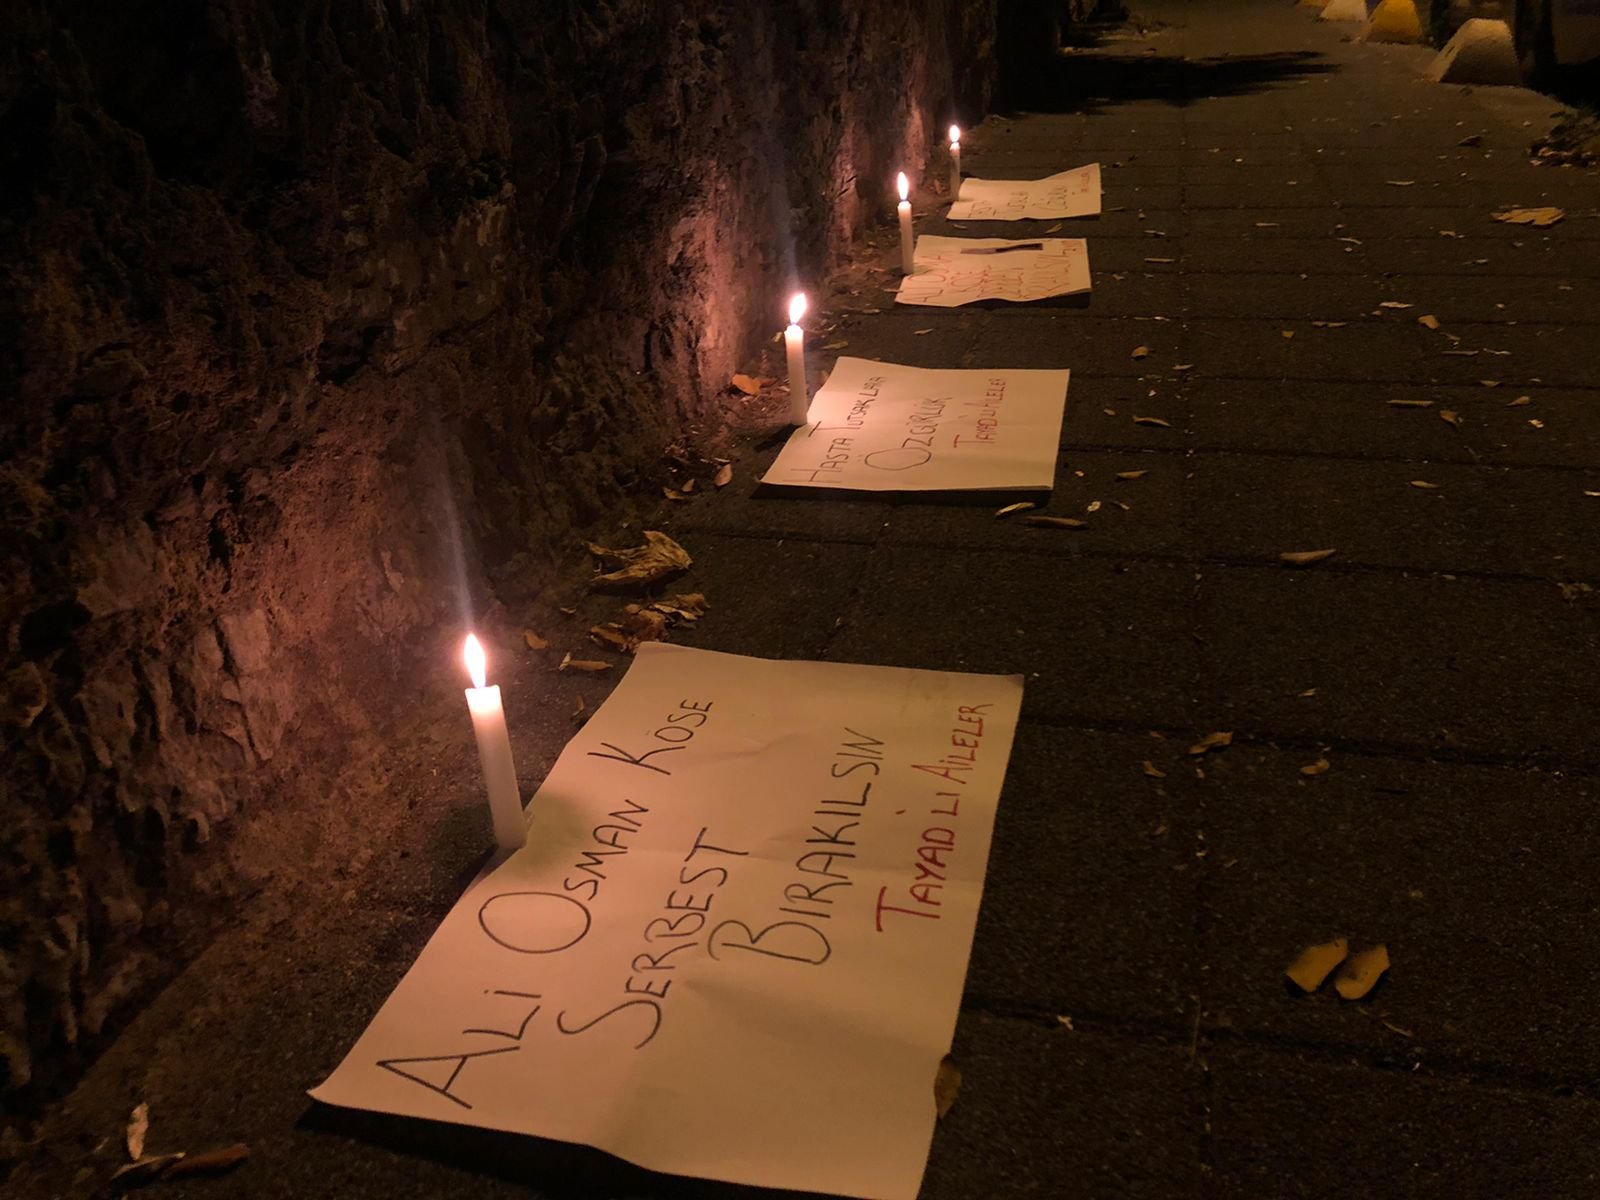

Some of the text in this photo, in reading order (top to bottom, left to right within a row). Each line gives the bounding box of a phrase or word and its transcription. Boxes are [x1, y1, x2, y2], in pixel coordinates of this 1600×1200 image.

[782, 437, 854, 484] HASTA
[478, 799, 649, 954] OSMAN
[556, 827, 749, 1050] SERBEST
[707, 727, 885, 965] BIRAKILSIN
